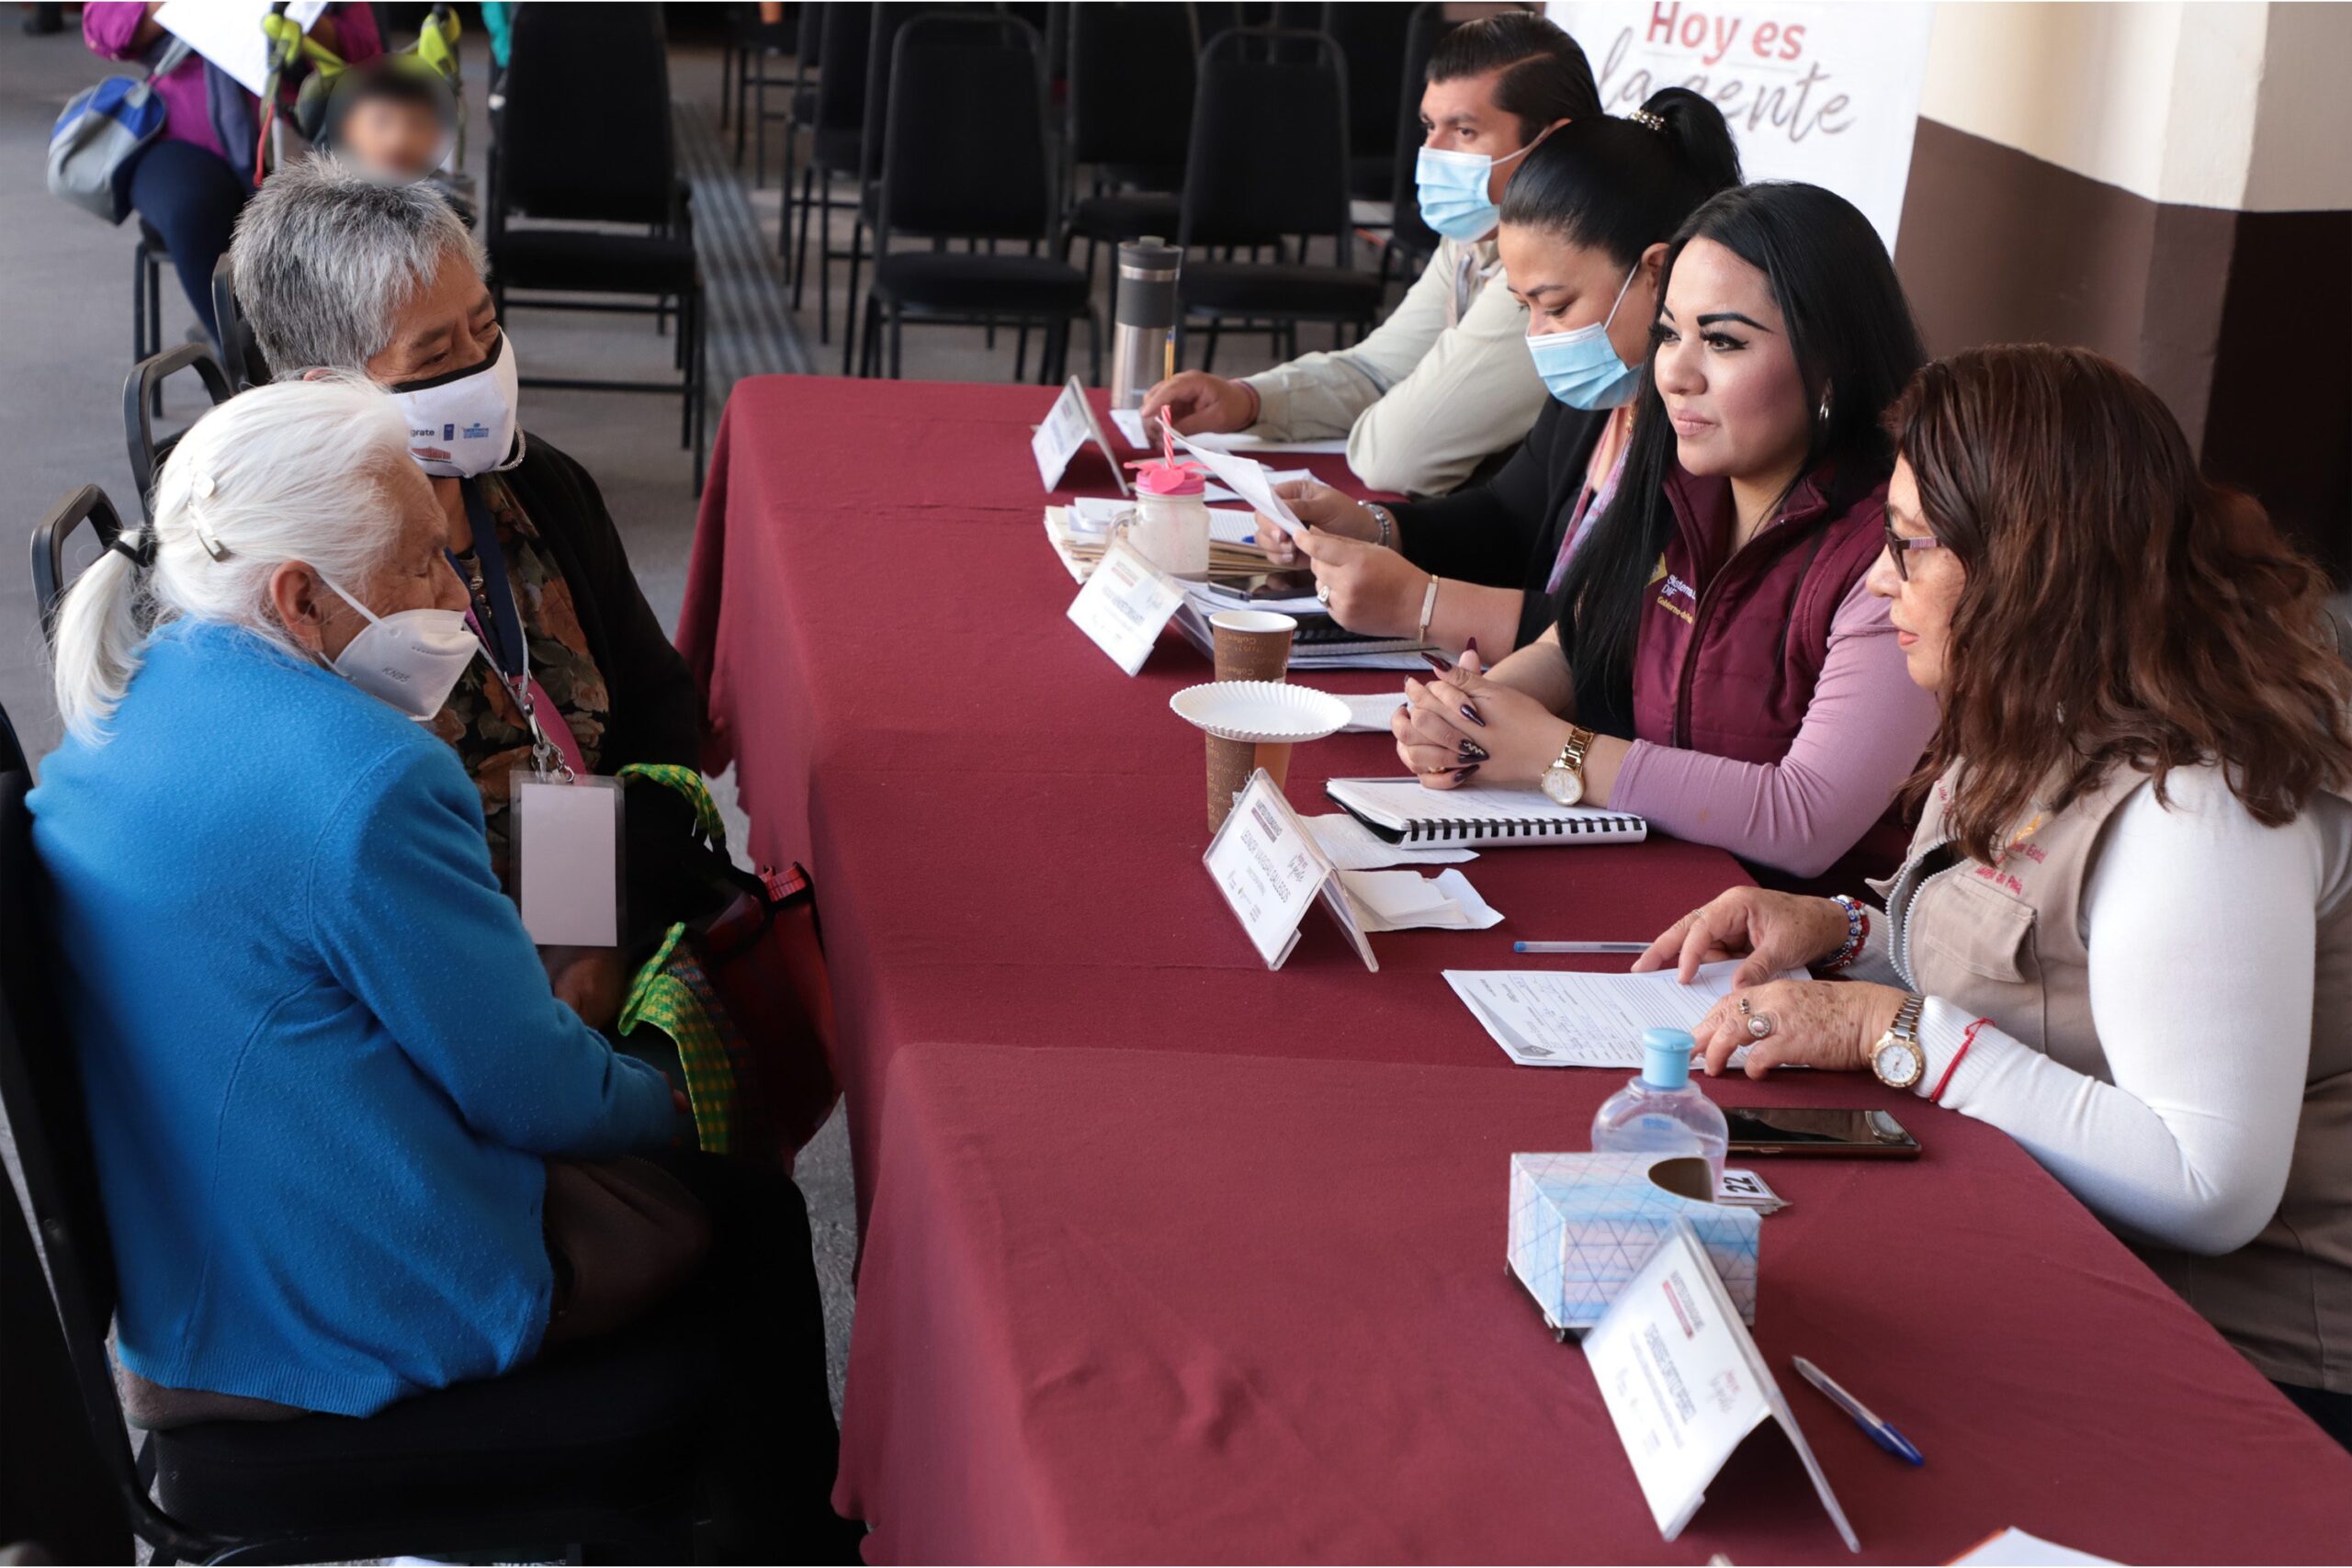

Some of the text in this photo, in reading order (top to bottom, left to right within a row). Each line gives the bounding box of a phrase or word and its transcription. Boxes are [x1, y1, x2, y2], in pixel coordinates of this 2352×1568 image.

[1646, 1, 1806, 66] Hoy es
[381, 667, 411, 682] KN95
[1724, 1177, 1760, 1193] 22
